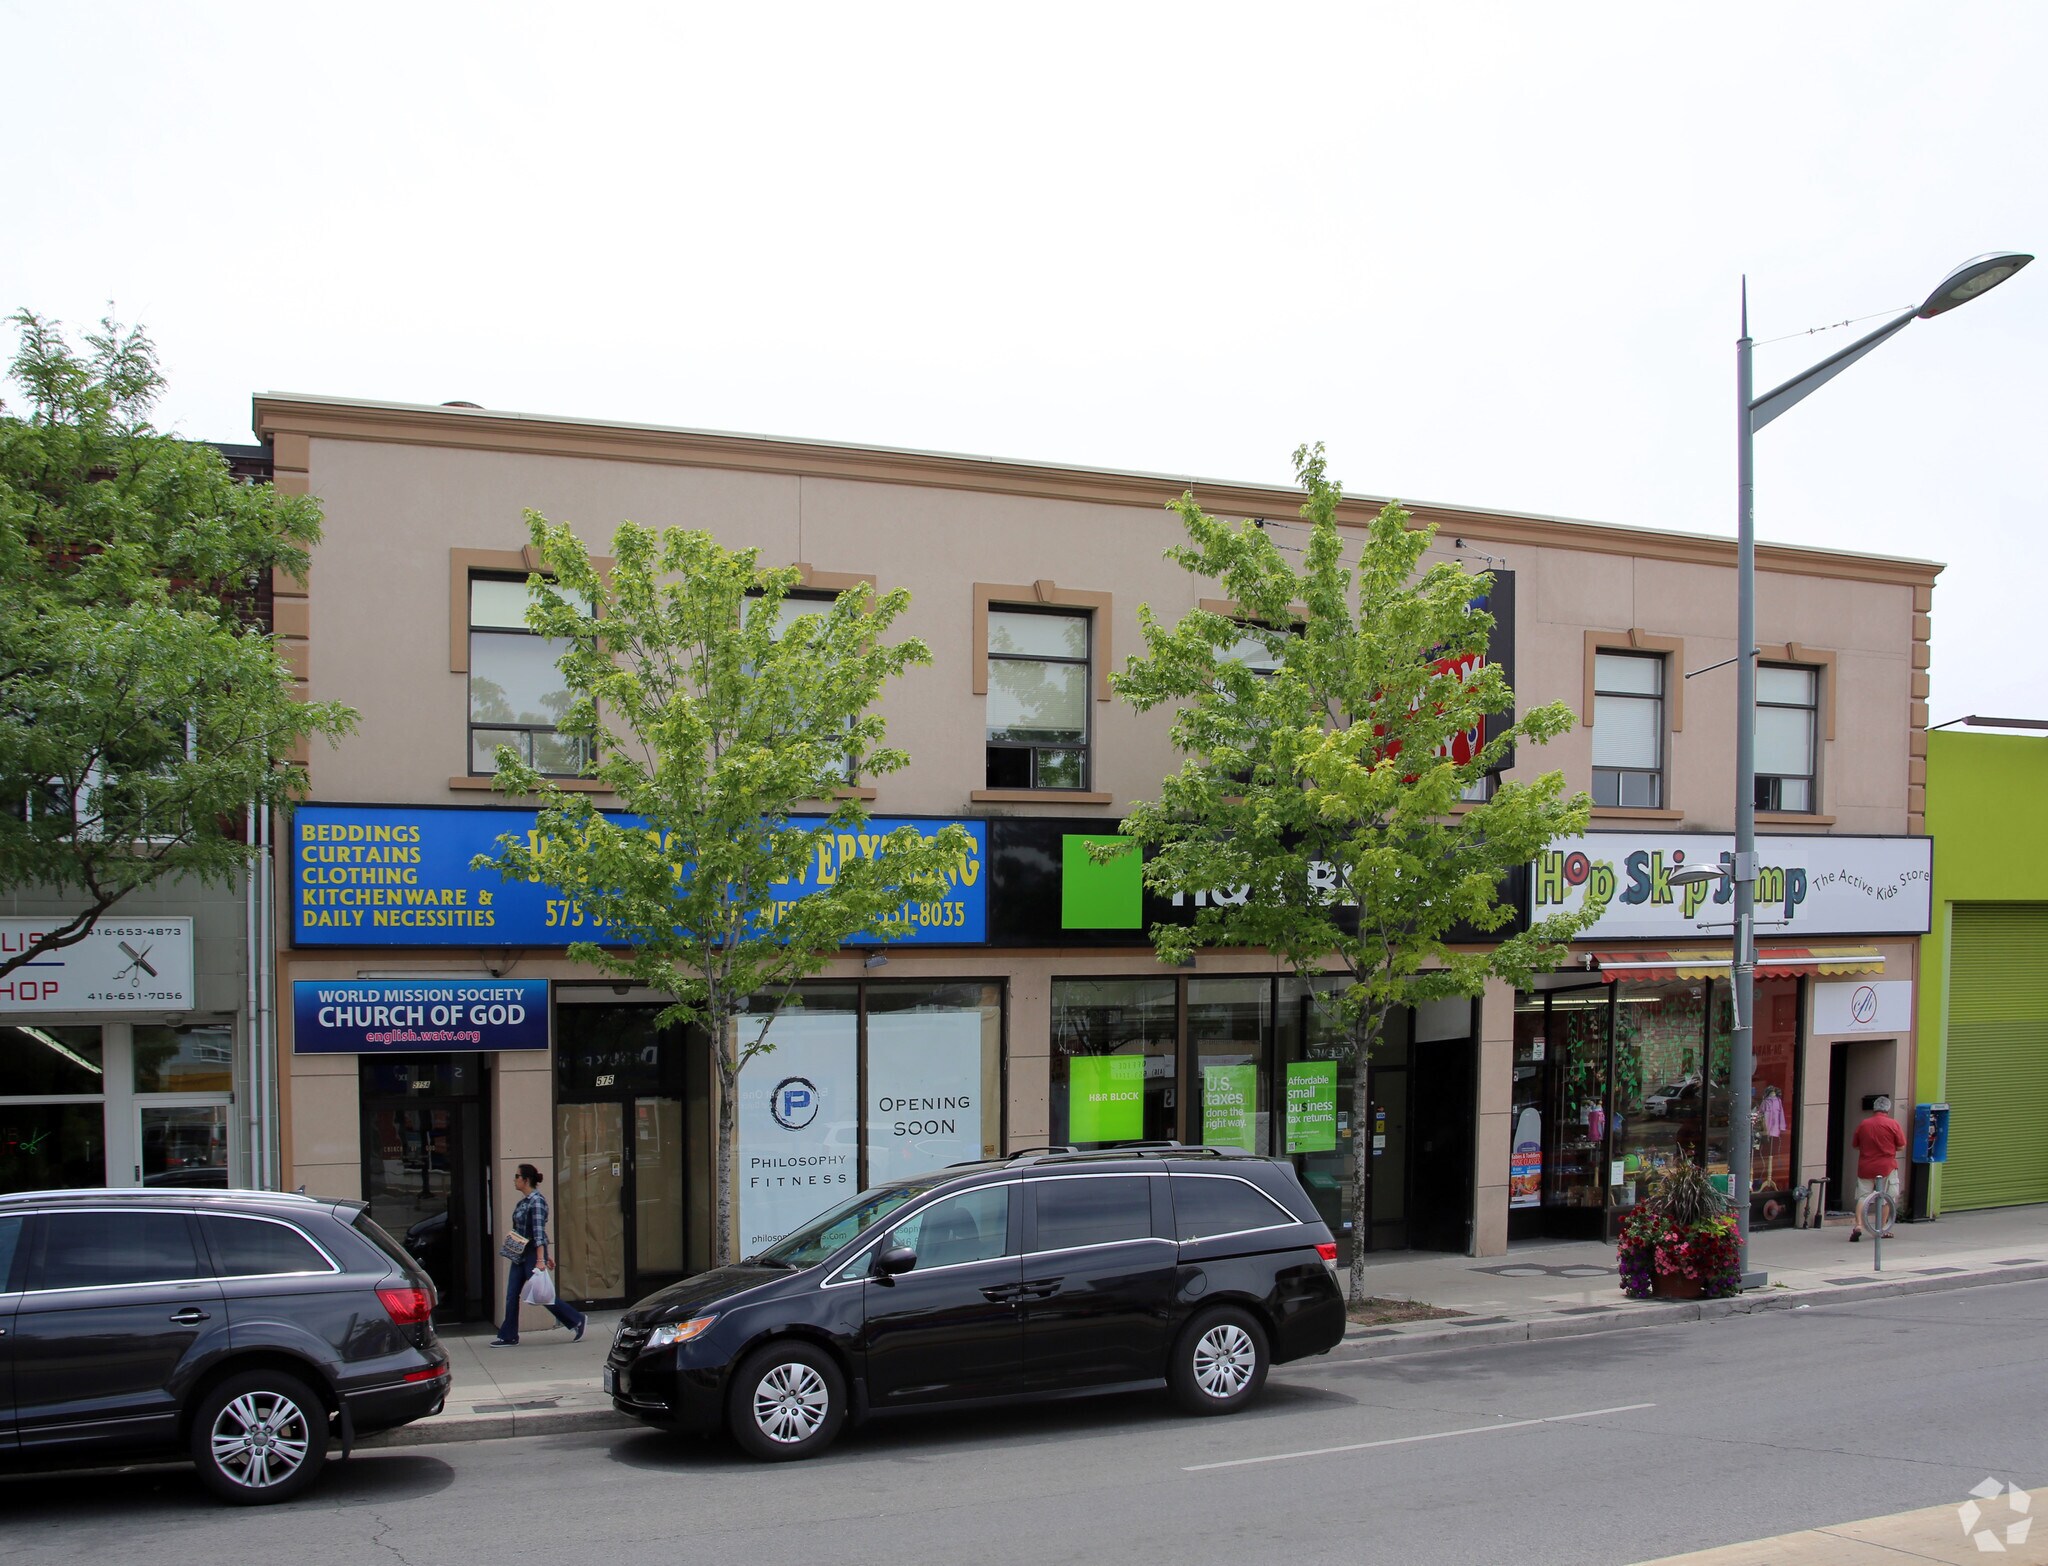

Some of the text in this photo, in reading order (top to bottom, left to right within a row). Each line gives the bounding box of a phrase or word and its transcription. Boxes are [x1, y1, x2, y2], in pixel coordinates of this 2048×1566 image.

[302, 824, 421, 843] BEDDINGS
[302, 846, 421, 863] CURTAINS
[302, 868, 418, 885] CLOTHING
[1713, 851, 1807, 919] Jmp
[1812, 869, 1930, 901] The Active Kids Store
[302, 889, 493, 906] KITCHENWARE &
[303, 910, 495, 927] DAILY NECESSITIES
[545, 900, 585, 927] 575
[88, 928, 182, 936] 416-653-4873
[87, 992, 183, 1000] 416-651-7056
[318, 988, 525, 1003] WORLD MISSION SOCIETY
[318, 1004, 526, 1028] CHURCH OF GOD
[366, 1029, 481, 1045] english.watv.org
[597, 1076, 613, 1086] 575
[1207, 1076, 1233, 1092] U.S.
[1288, 1075, 1329, 1086] Affordable
[1089, 1092, 1139, 1102] H&R BLOCK
[1206, 1092, 1244, 1106] taxes
[1288, 1086, 1315, 1099] small
[784, 1090, 811, 1117] P
[879, 1096, 971, 1113] OPENING
[1206, 1107, 1244, 1118] done the
[1288, 1114, 1301, 1124] tax
[1303, 1113, 1334, 1123] returns.
[893, 1119, 955, 1137] SOON
[1206, 1119, 1247, 1130] right way.
[751, 1154, 847, 1169] PHILOSOPHY
[751, 1173, 847, 1188] FITNESS
